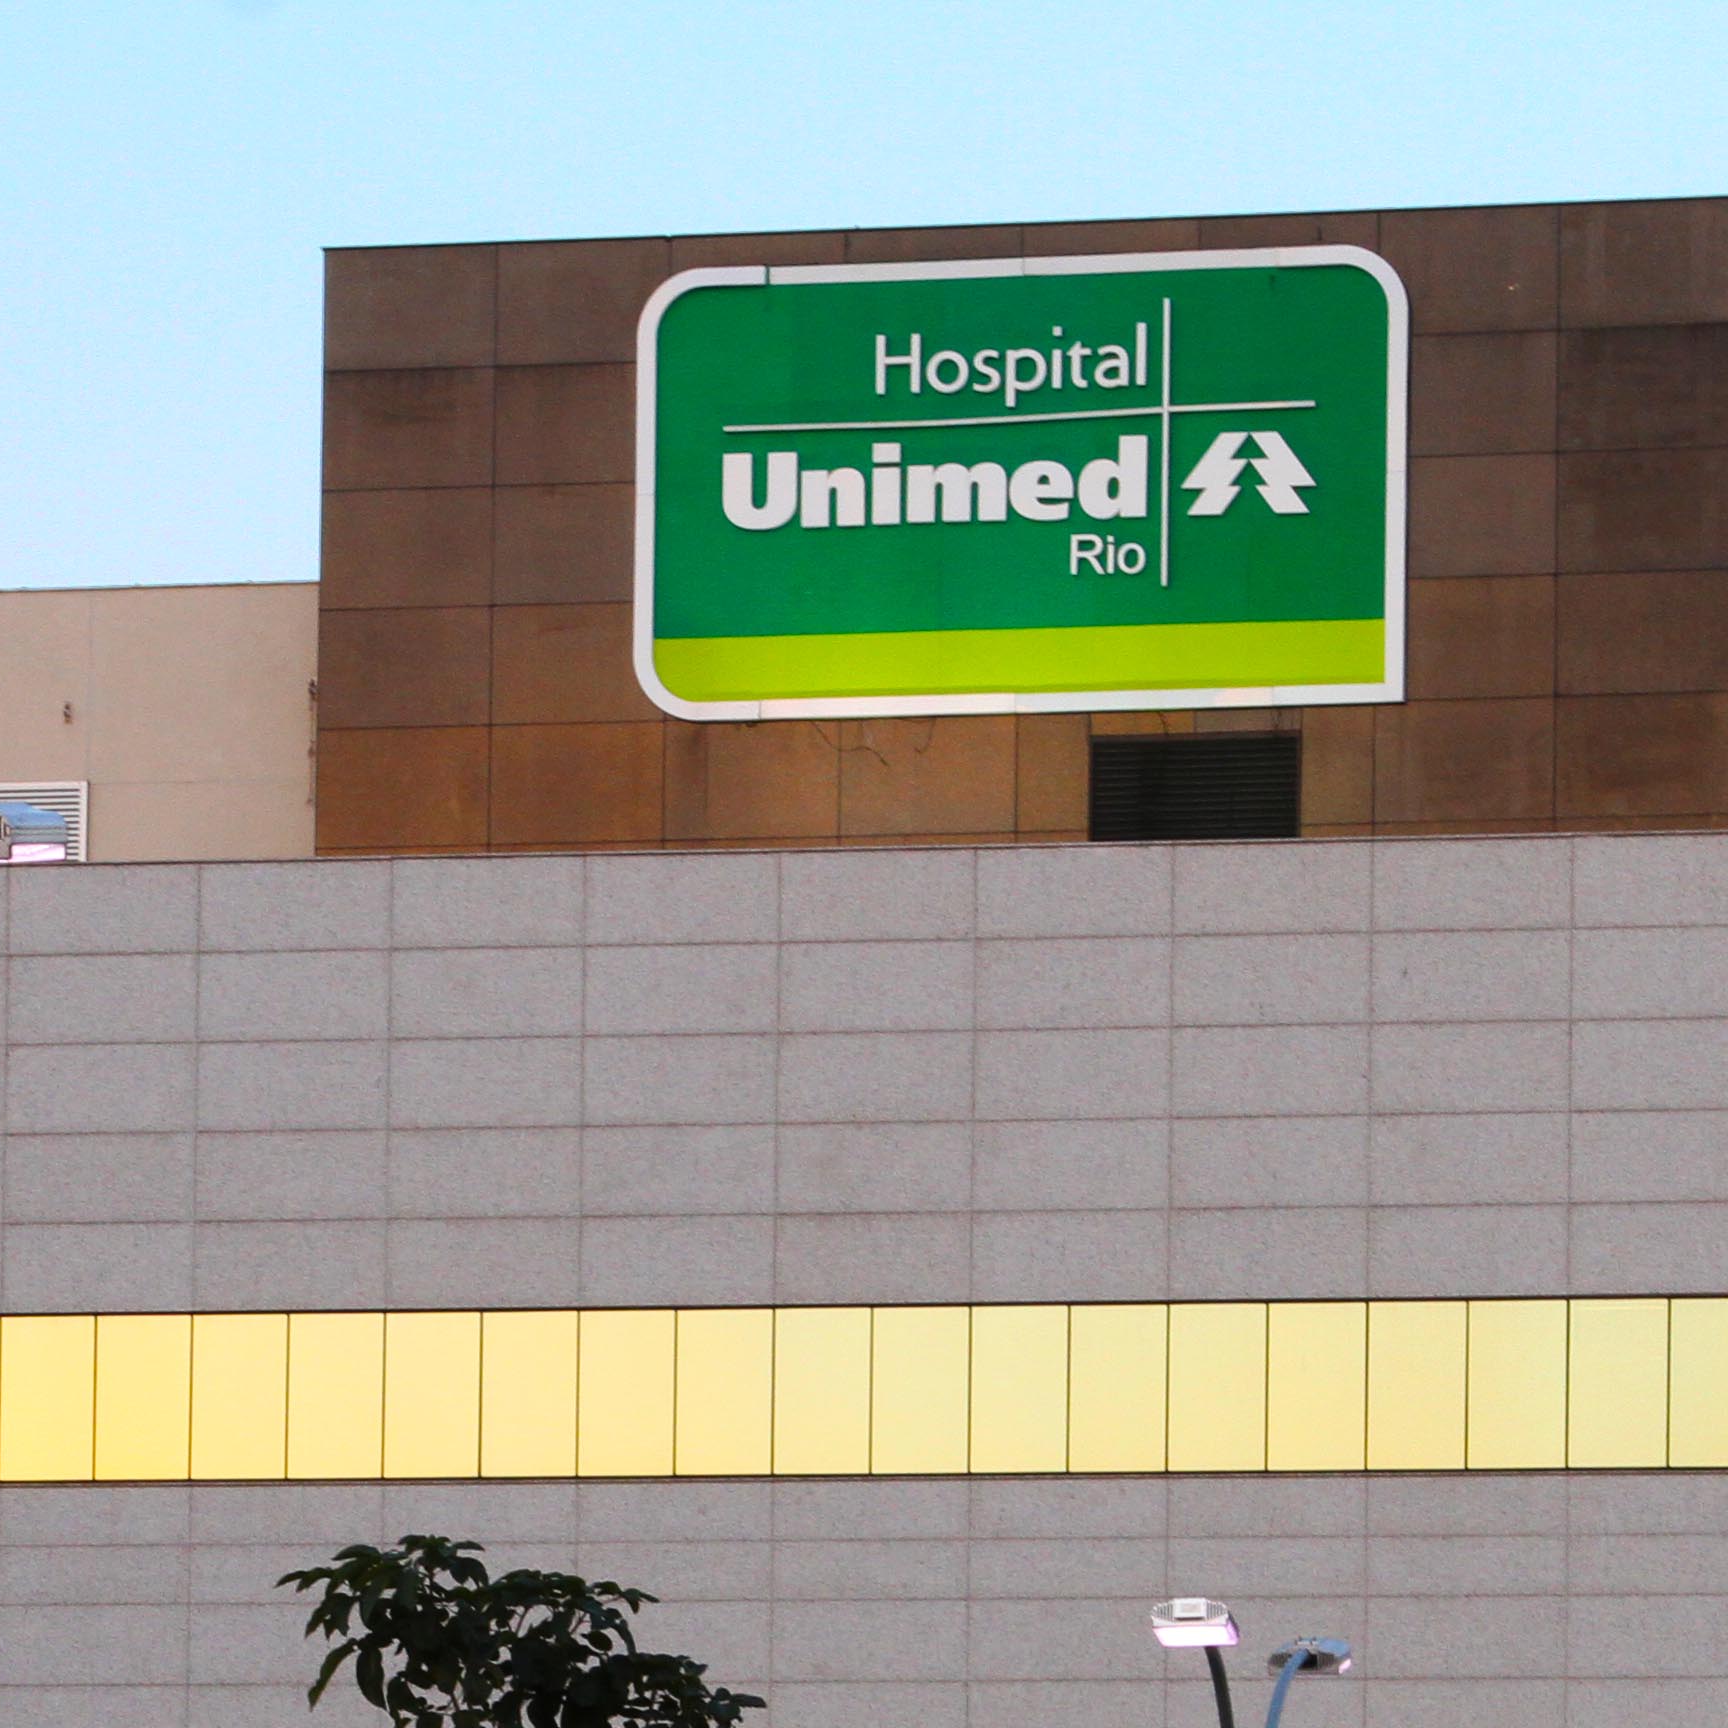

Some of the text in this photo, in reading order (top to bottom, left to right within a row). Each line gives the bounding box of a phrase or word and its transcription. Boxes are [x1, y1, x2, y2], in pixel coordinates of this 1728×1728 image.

[875, 321, 1147, 408] Hospital
[721, 435, 1148, 531] Unimed
[1069, 534, 1146, 575] Rio
